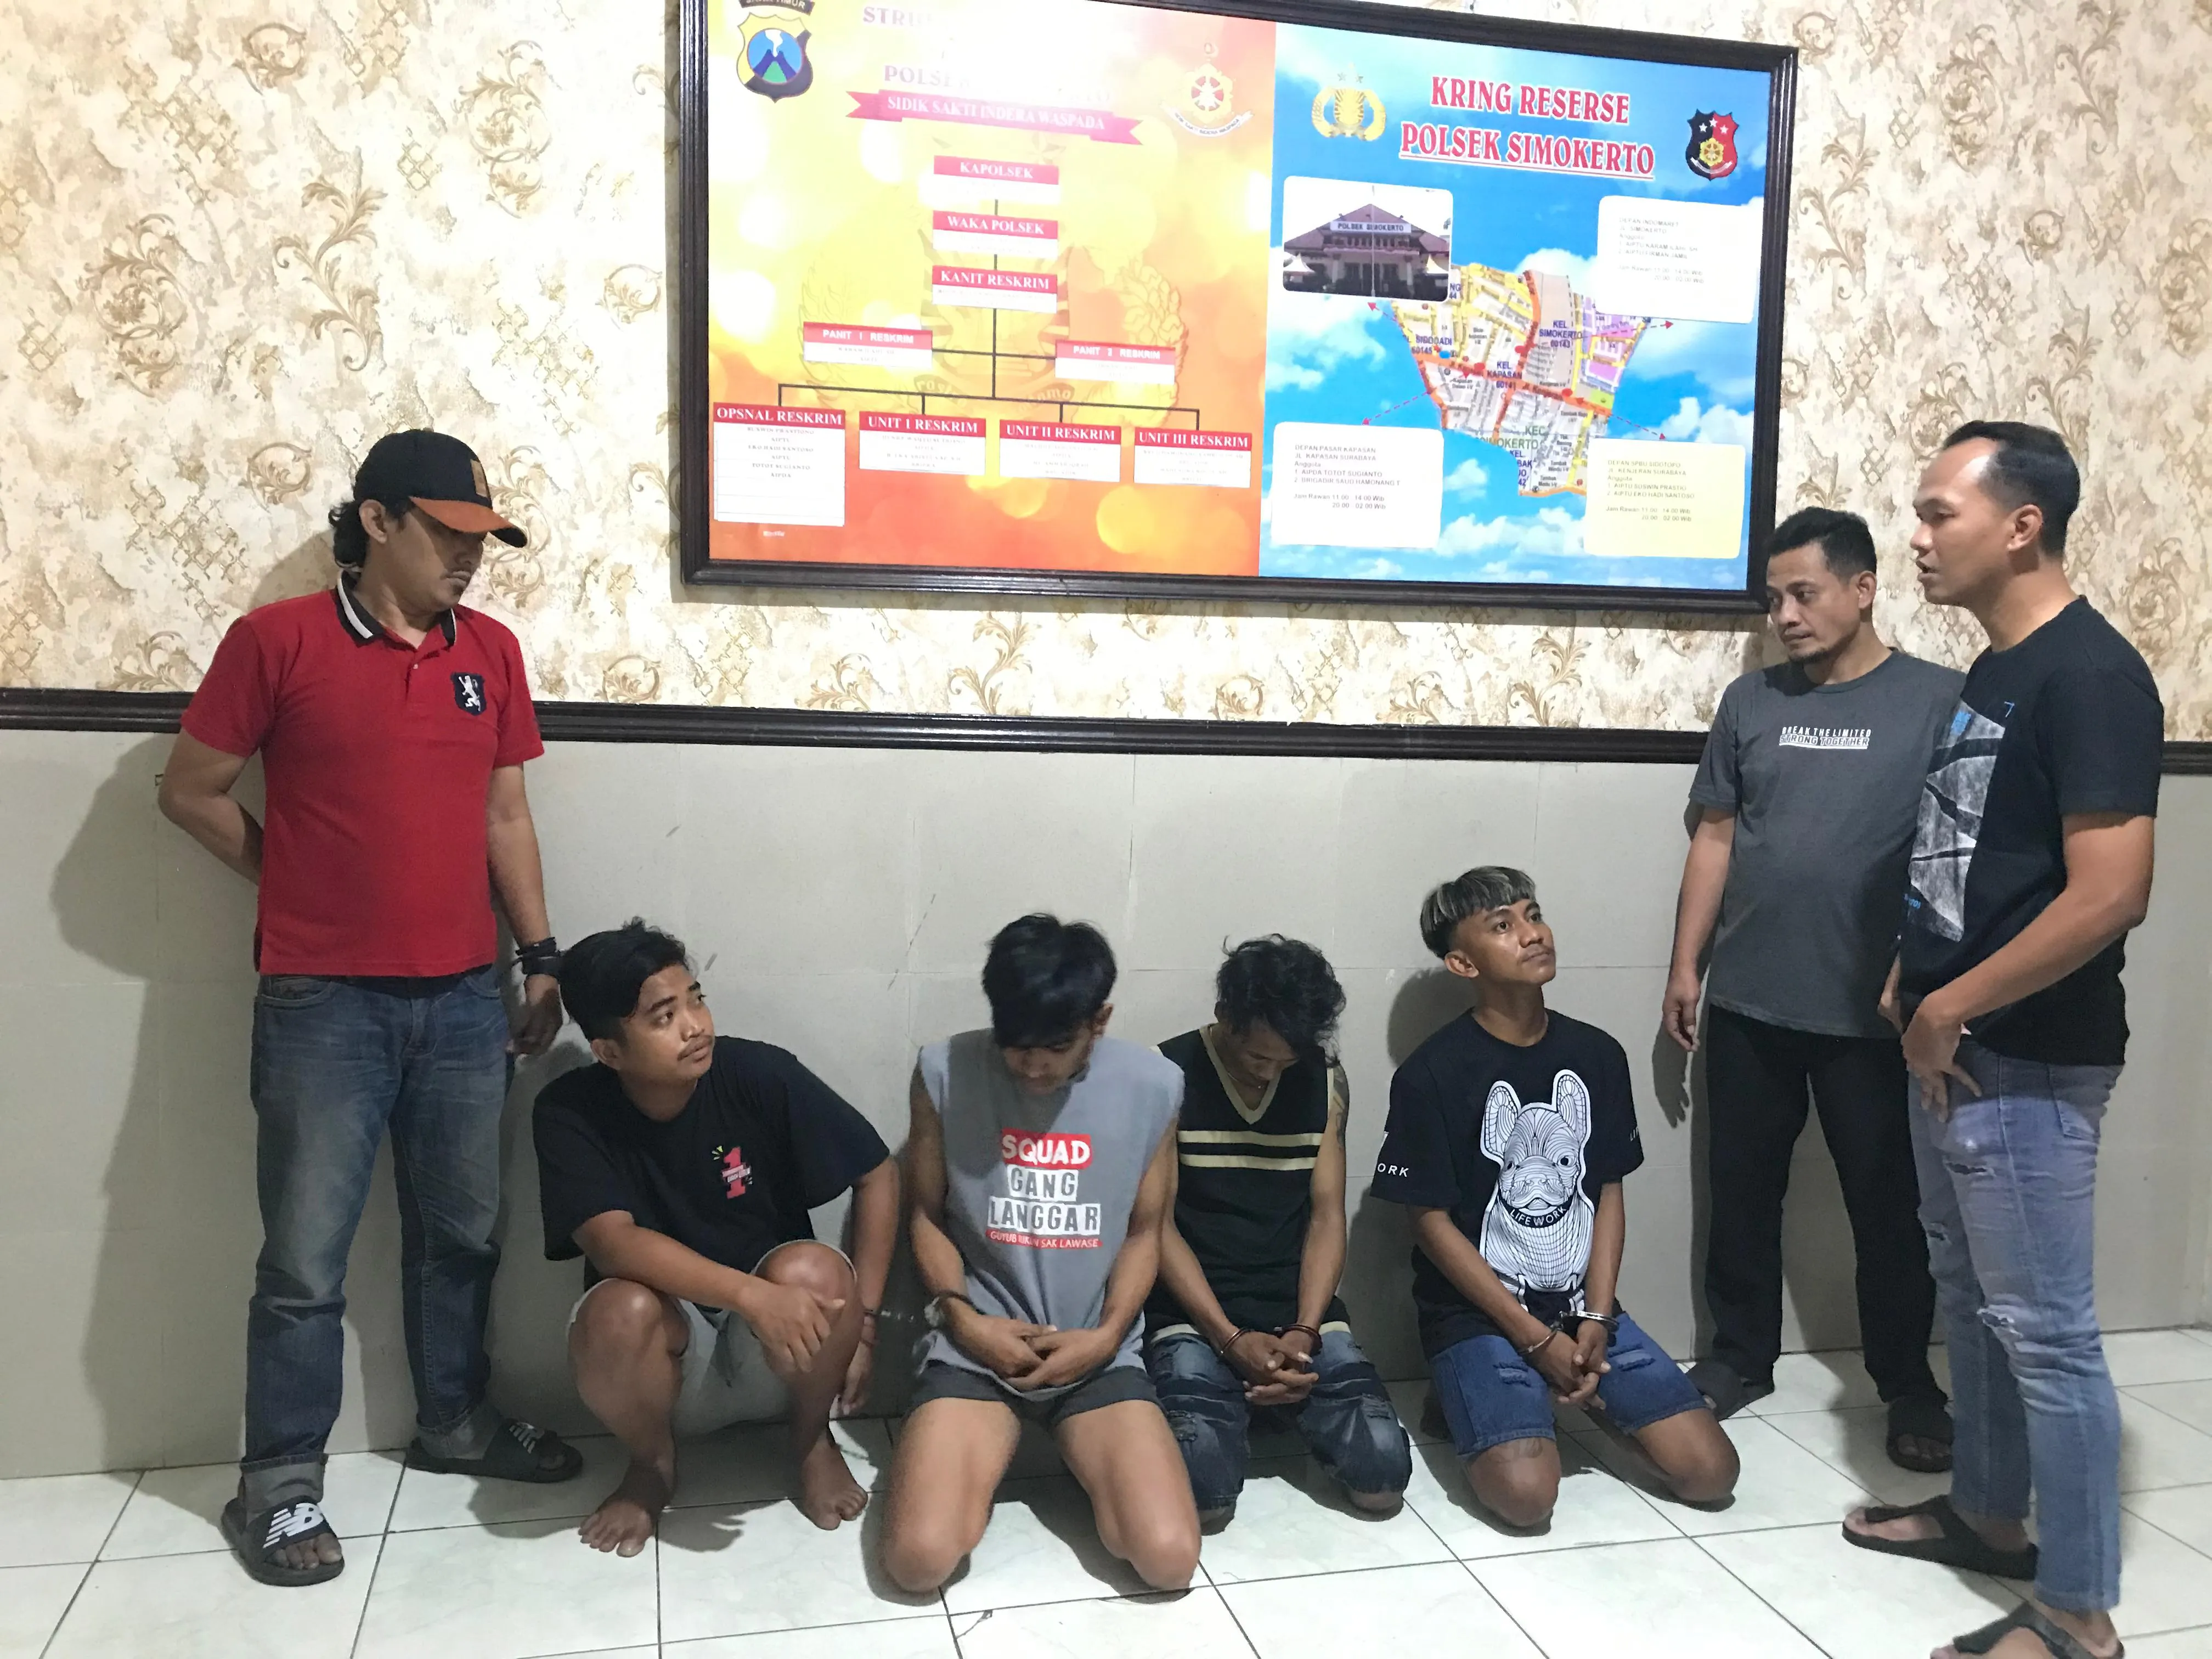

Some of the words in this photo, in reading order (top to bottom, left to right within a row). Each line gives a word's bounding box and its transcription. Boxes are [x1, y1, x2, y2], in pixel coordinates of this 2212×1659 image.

[1431, 76, 1511, 112] KRING
[1520, 86, 1630, 125] RESERSE
[888, 96, 929, 112] SIDIK
[1037, 110, 1104, 129] WASPADA
[1401, 123, 1500, 160] POLSEK
[1507, 133, 1655, 175] SIMOKERTO
[960, 162, 1033, 179] KAPOLSEK
[947, 216, 988, 229] WAKA
[992, 219, 1044, 234] POLSEK
[941, 270, 984, 284] KANIT
[988, 274, 1049, 290] RESKRIM
[823, 329, 851, 340] PANIT
[871, 332, 913, 343] RESKRIM
[1073, 346, 1101, 355] PANIT
[1120, 349, 1160, 359] RESKRIM
[717, 408, 774, 421] OPSNAL
[777, 411, 842, 425] RESKRIM
[868, 416, 901, 428] UNIT
[915, 419, 978, 433] RESKRIM
[1007, 425, 1039, 436] UNIT
[1056, 428, 1115, 441] RESKRIM
[1139, 432, 1170, 444] UNIT
[1190, 436, 1249, 448] RESKRIM
[1782, 726, 1810, 735] BREAK
[1780, 734, 1818, 745] STRONG
[1820, 737, 1870, 746] TOGETHER
[1002, 1135, 1091, 1165] SQUAD
[1011, 1168, 1075, 1198] GANG
[990, 1200, 1097, 1231] LANGGAR
[1510, 1206, 1566, 1226] LIFEWORK
[1060, 1239, 1098, 1248] LAWASE
